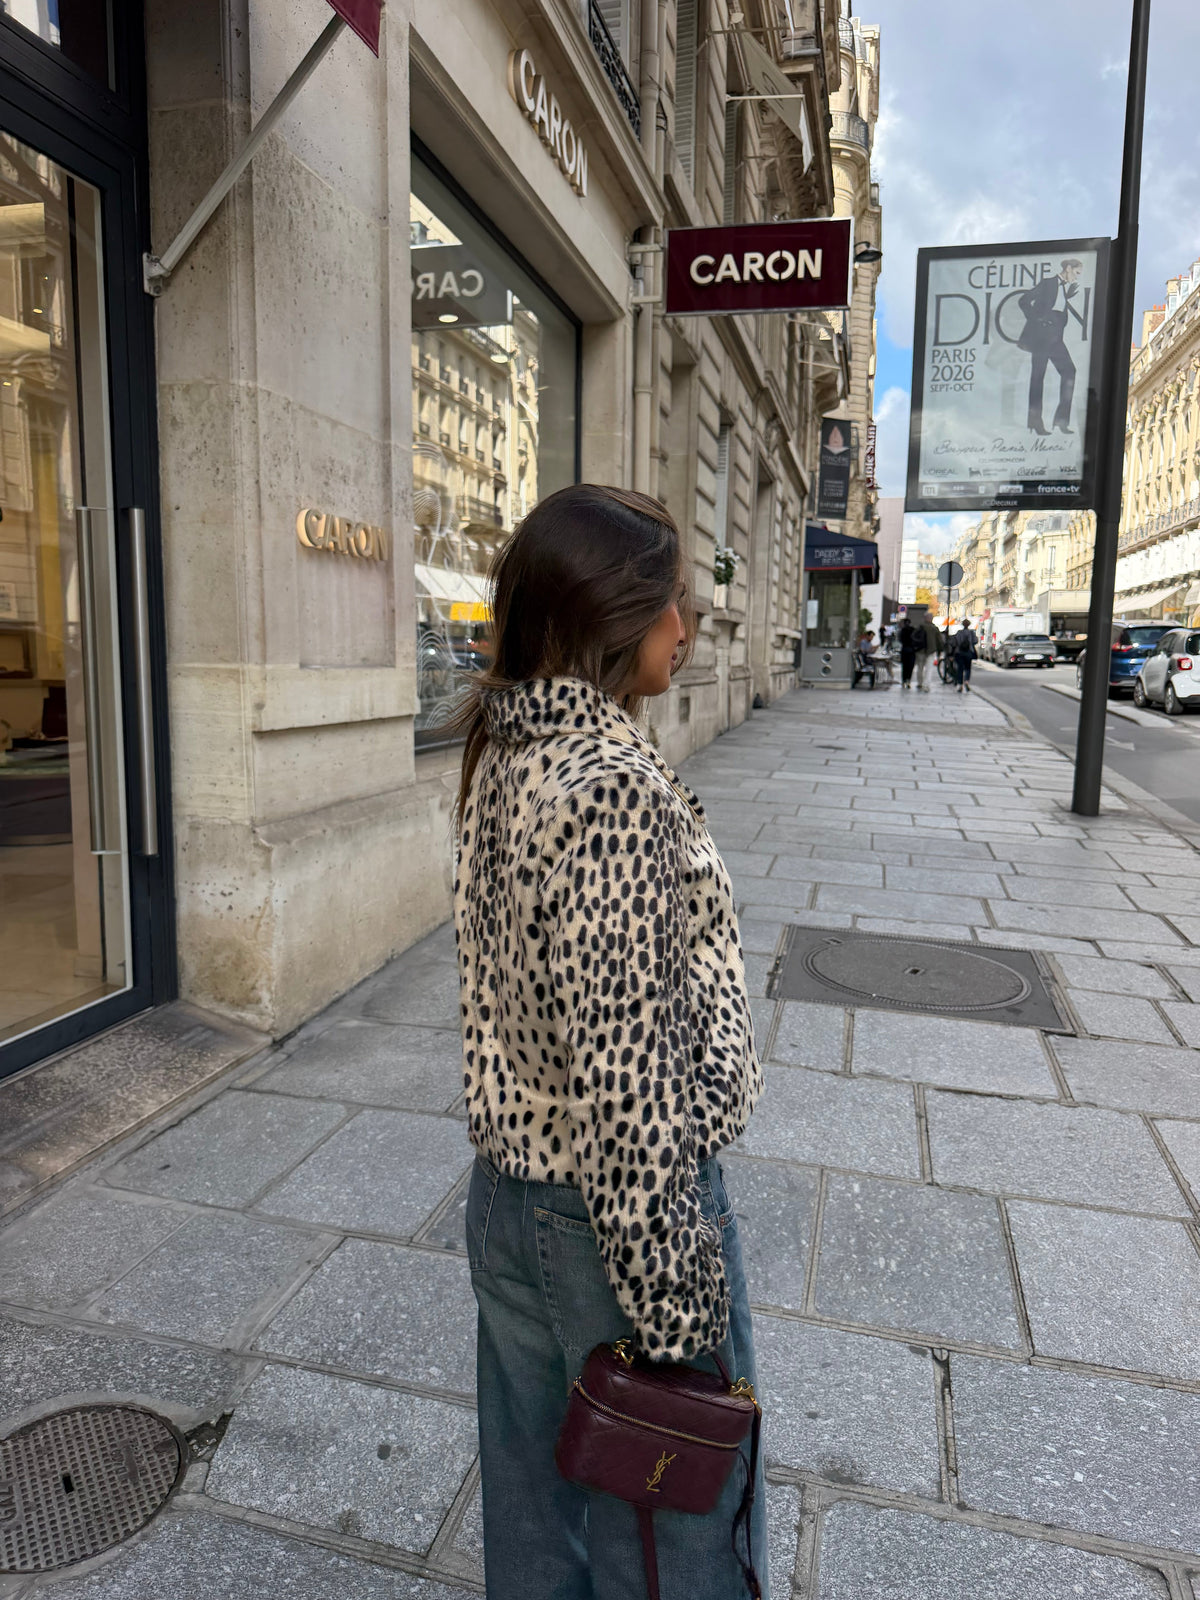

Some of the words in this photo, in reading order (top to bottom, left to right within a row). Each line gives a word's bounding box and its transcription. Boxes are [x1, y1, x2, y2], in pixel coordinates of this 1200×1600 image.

[508, 48, 588, 198] CARON
[689, 248, 823, 286] CARON
[967, 259, 1053, 290] CÉLINE
[932, 287, 1092, 347] DION
[930, 348, 977, 364] PARIS
[930, 364, 975, 382] 2026
[296, 508, 389, 562] CARON
